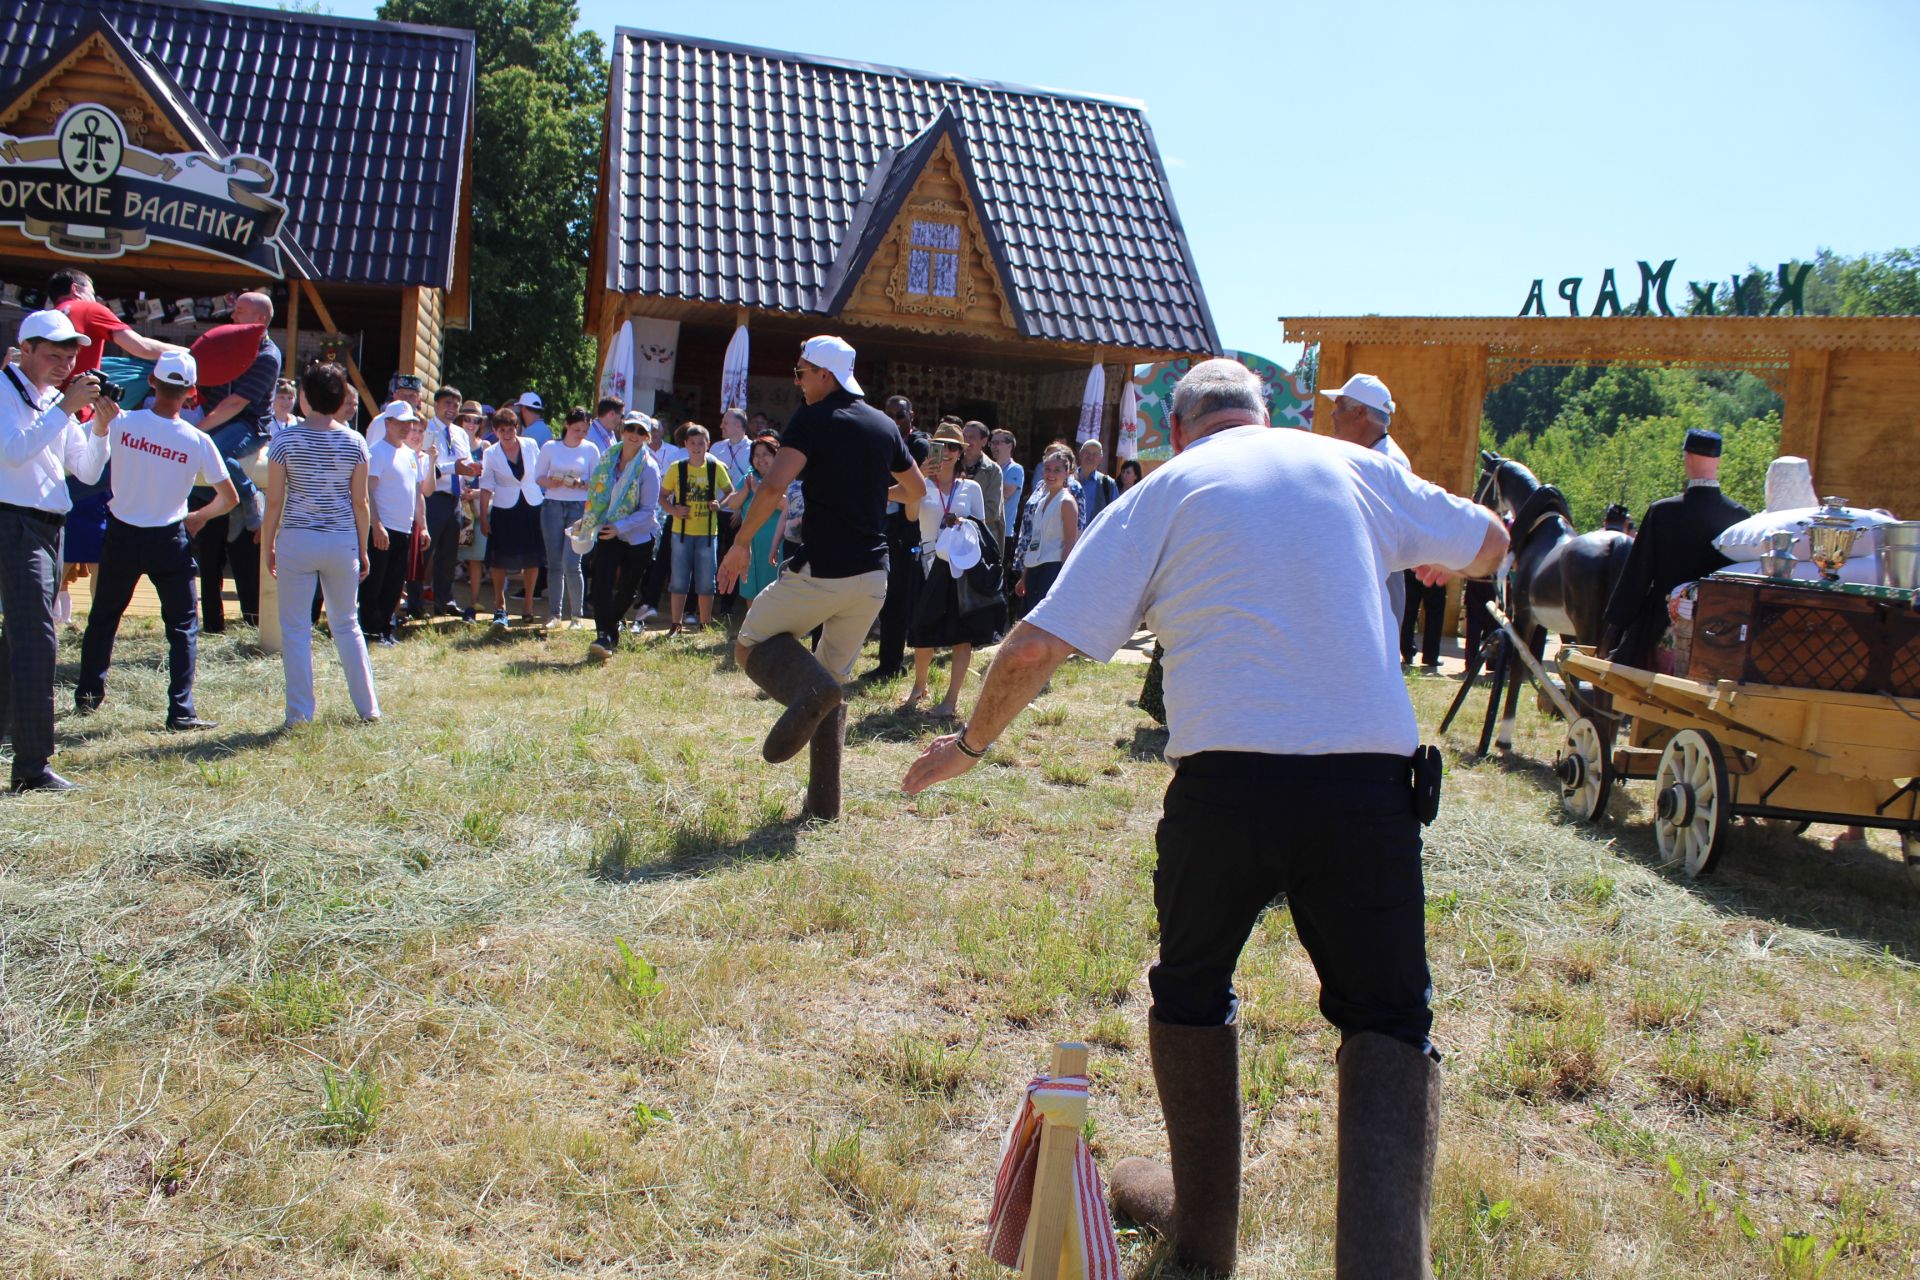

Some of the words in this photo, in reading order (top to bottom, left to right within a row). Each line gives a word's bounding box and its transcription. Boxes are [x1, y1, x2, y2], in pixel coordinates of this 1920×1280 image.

[0, 179, 112, 215] ОРСКИЕ
[123, 191, 255, 246] ВАЛЕНКИ
[120, 431, 188, 465] Kukmara
